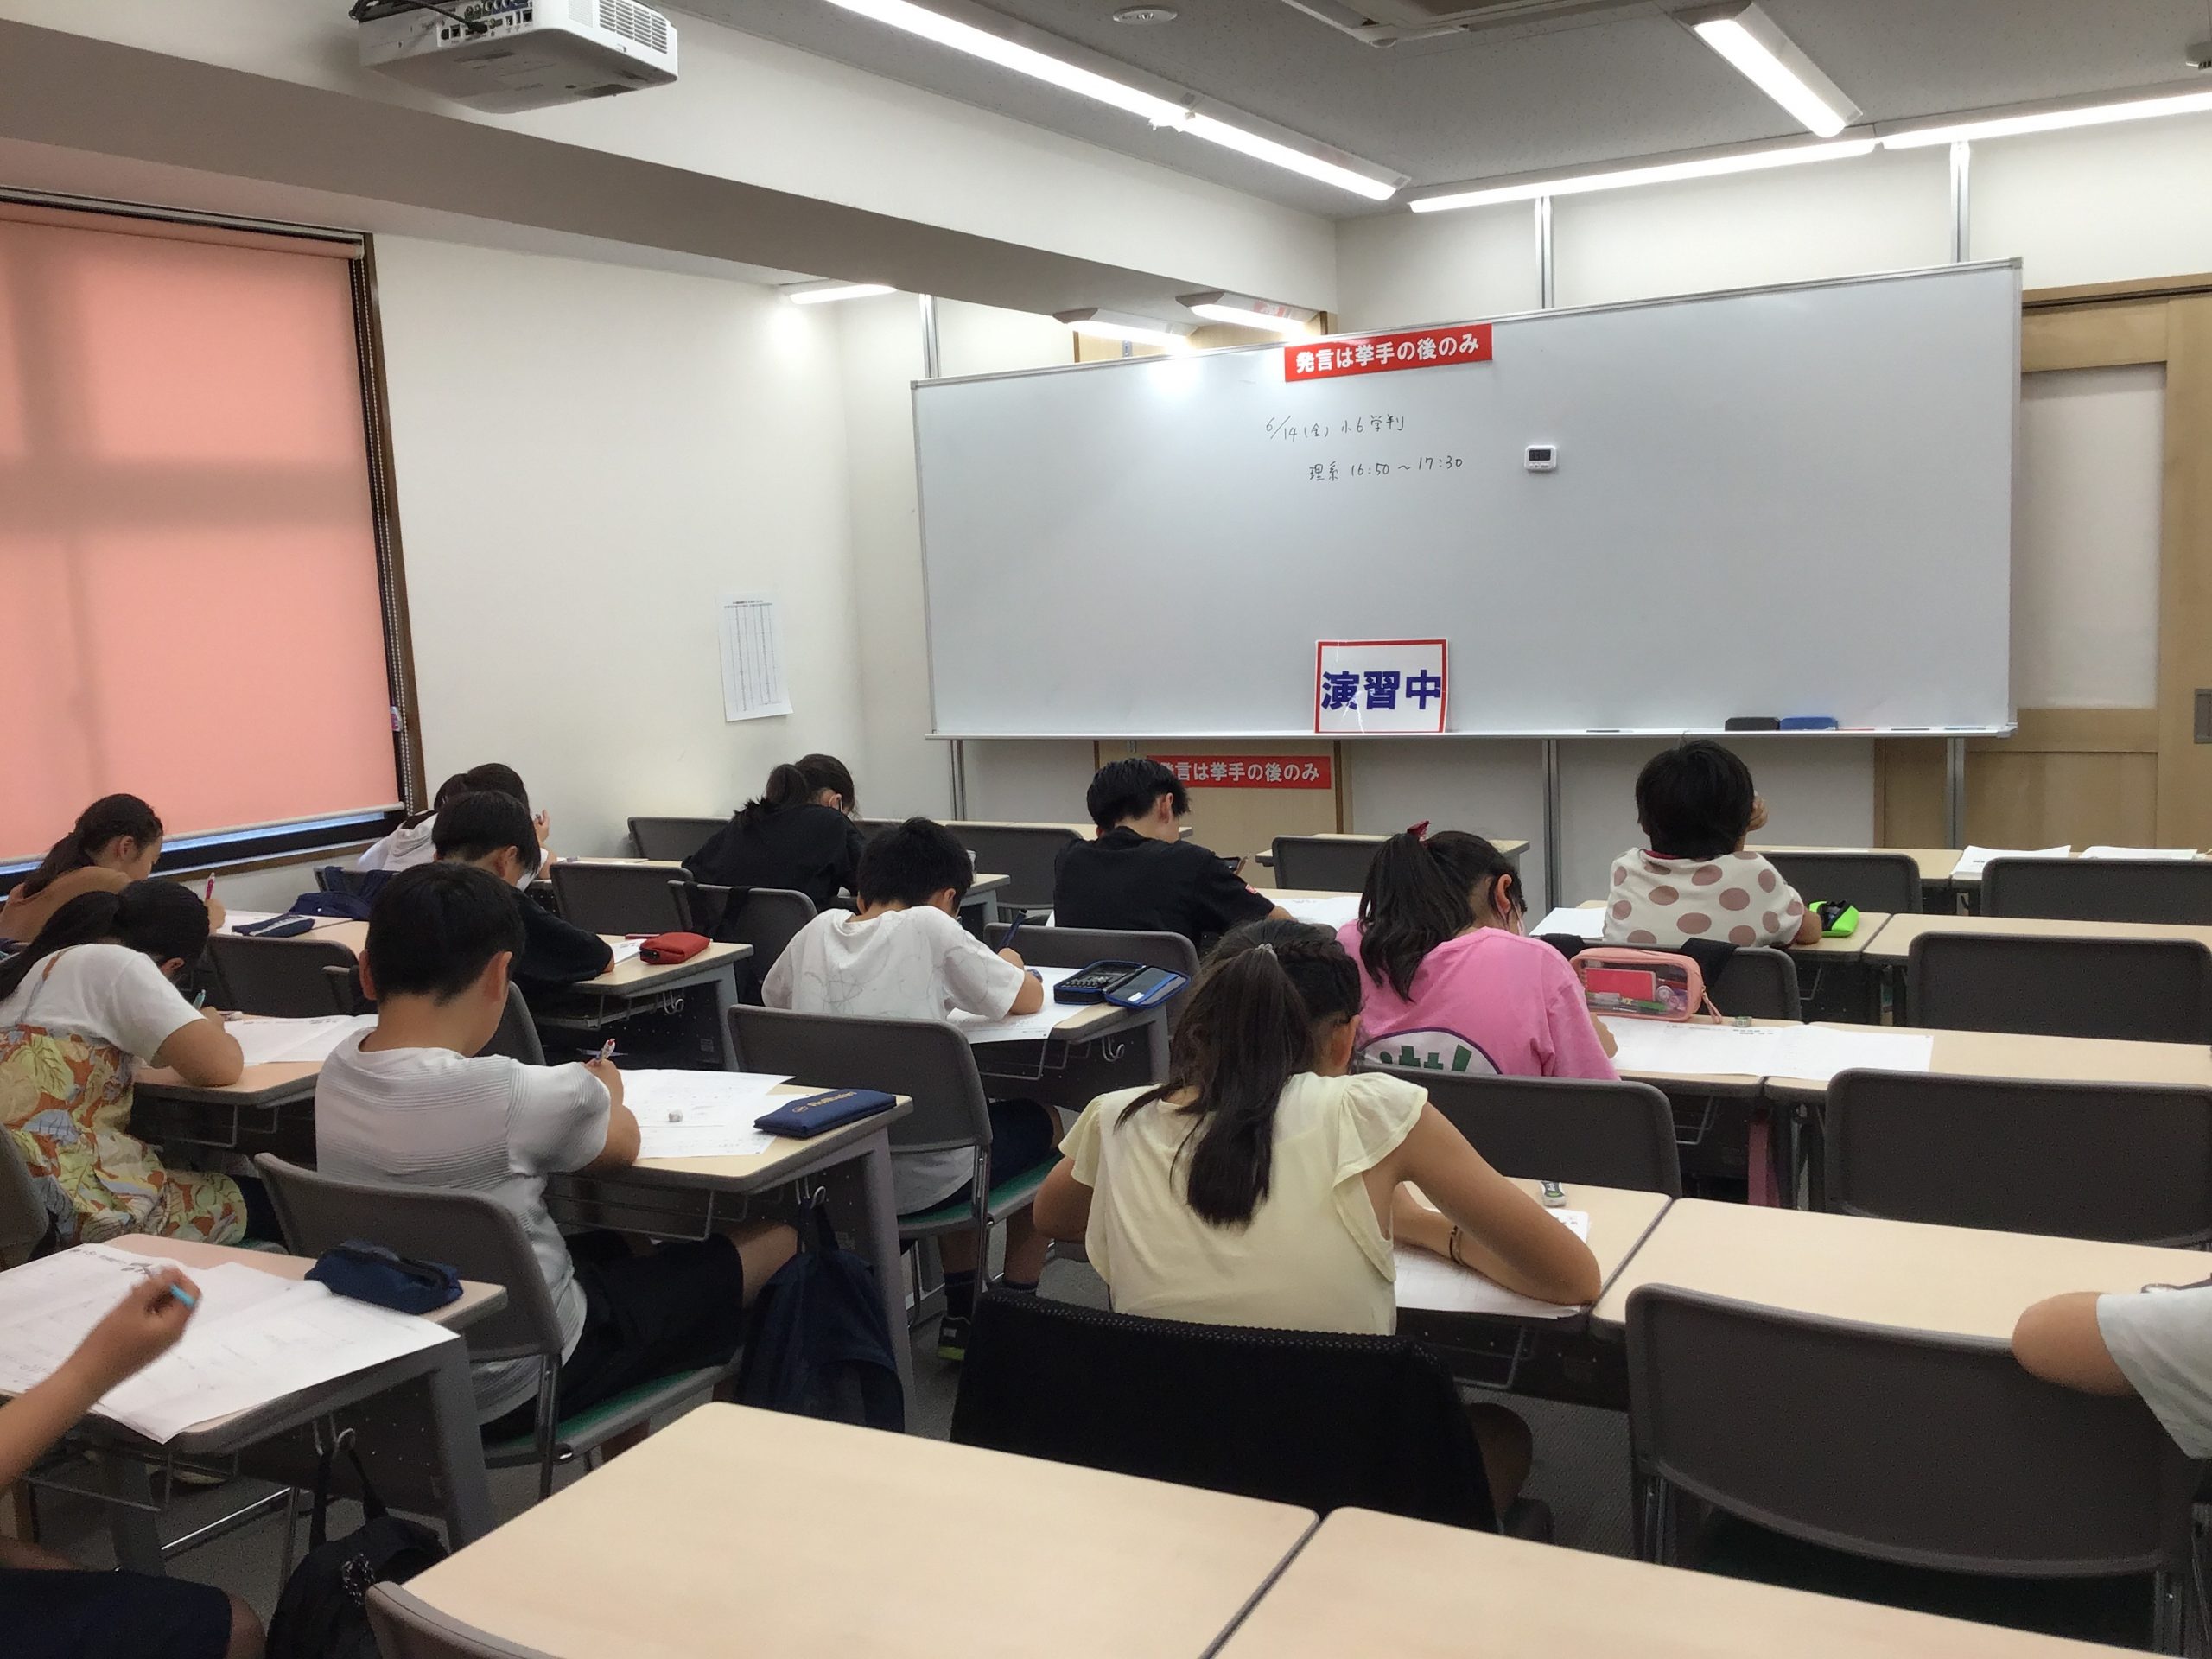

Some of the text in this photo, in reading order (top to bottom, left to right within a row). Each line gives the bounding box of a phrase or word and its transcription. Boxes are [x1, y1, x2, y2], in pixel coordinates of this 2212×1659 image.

[1296, 334, 1479, 374] 発言は挙手の後のみ
[1321, 669, 1441, 709] 演習中
